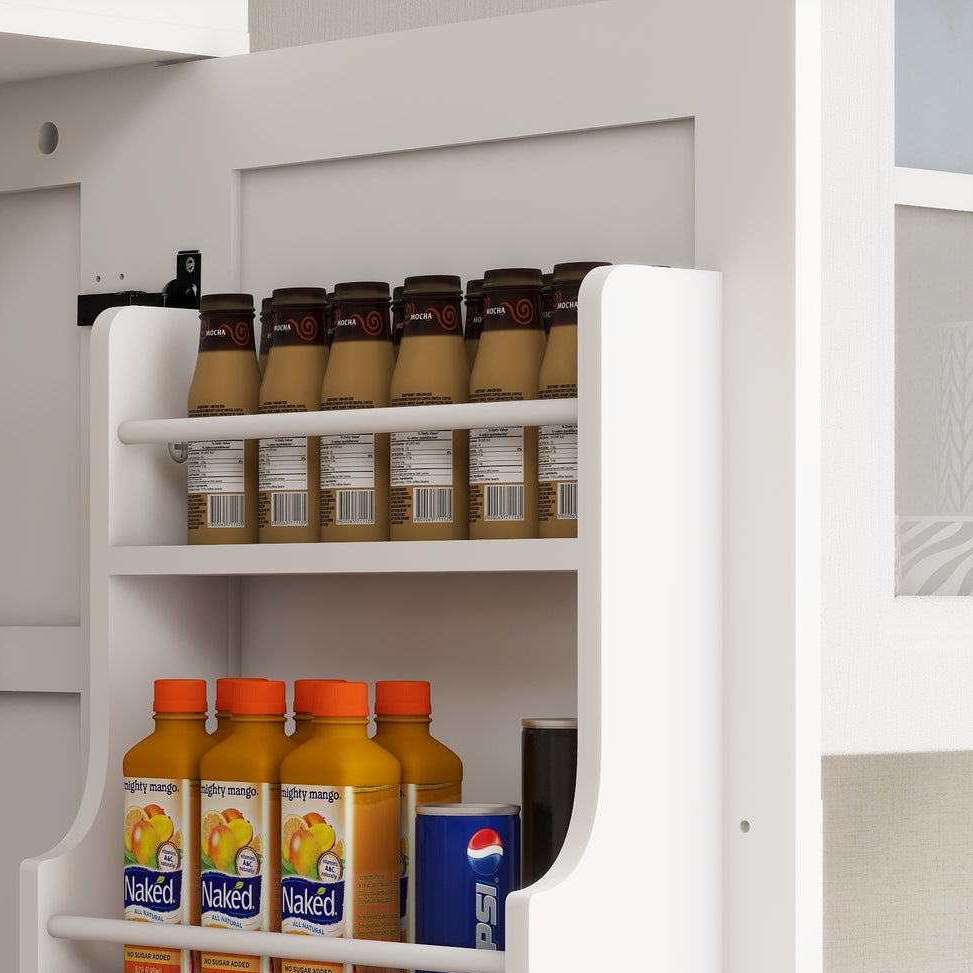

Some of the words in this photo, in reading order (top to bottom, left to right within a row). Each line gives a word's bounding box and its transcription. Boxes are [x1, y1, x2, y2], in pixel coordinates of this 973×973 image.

[557, 301, 578, 309] MOCHA
[487, 307, 506, 315] MOCHA
[228, 786, 259, 799] mango.
[309, 790, 342, 803] mango.
[143, 911, 164, 921] NATURAL
[221, 917, 243, 928] NATURAL
[302, 923, 325, 935] NATURAL
[293, 966, 311, 973] SUGAR
